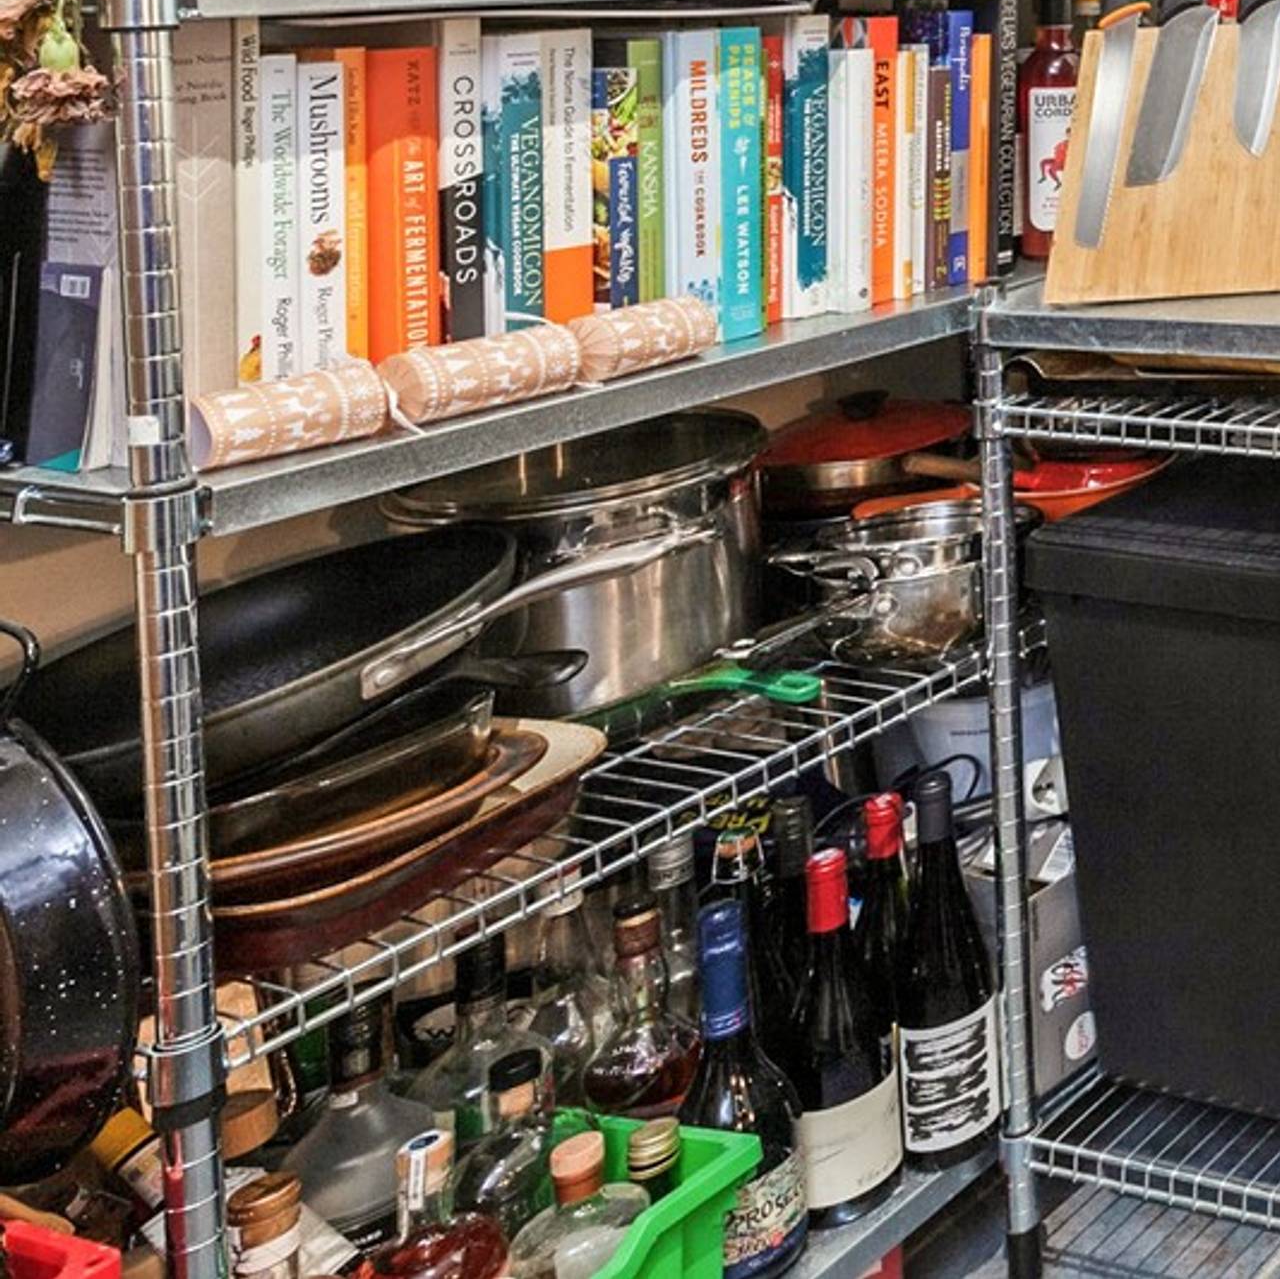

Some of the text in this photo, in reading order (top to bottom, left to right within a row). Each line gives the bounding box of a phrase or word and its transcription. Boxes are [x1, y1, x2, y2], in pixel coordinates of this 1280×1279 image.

[241, 34, 257, 67] Wild
[563, 47, 576, 67] The
[241, 68, 259, 103] Food
[407, 59, 421, 106] KATZ
[563, 70, 575, 103] Noma
[874, 60, 889, 110] EAST
[1000, 54, 1016, 141] VEGETARIAN
[1034, 94, 1076, 107] URB
[271, 88, 292, 122] The
[563, 106, 576, 140] Guide
[689, 60, 709, 164] MILDREDS
[1035, 108, 1072, 118] CORD
[309, 73, 338, 225] Mushrooms
[564, 143, 575, 155] to
[810, 84, 828, 247] VEGANOMICON
[272, 127, 294, 215] Worldwide
[403, 160, 426, 194] ART
[453, 75, 477, 284] CROSSROADS
[641, 140, 657, 219] KANSHA
[998, 145, 1015, 235] COLLECTION
[520, 116, 543, 307] VEGANOMICON
[737, 185, 750, 216] LEE
[737, 223, 751, 295] WATSON
[270, 297, 293, 337] Roger
